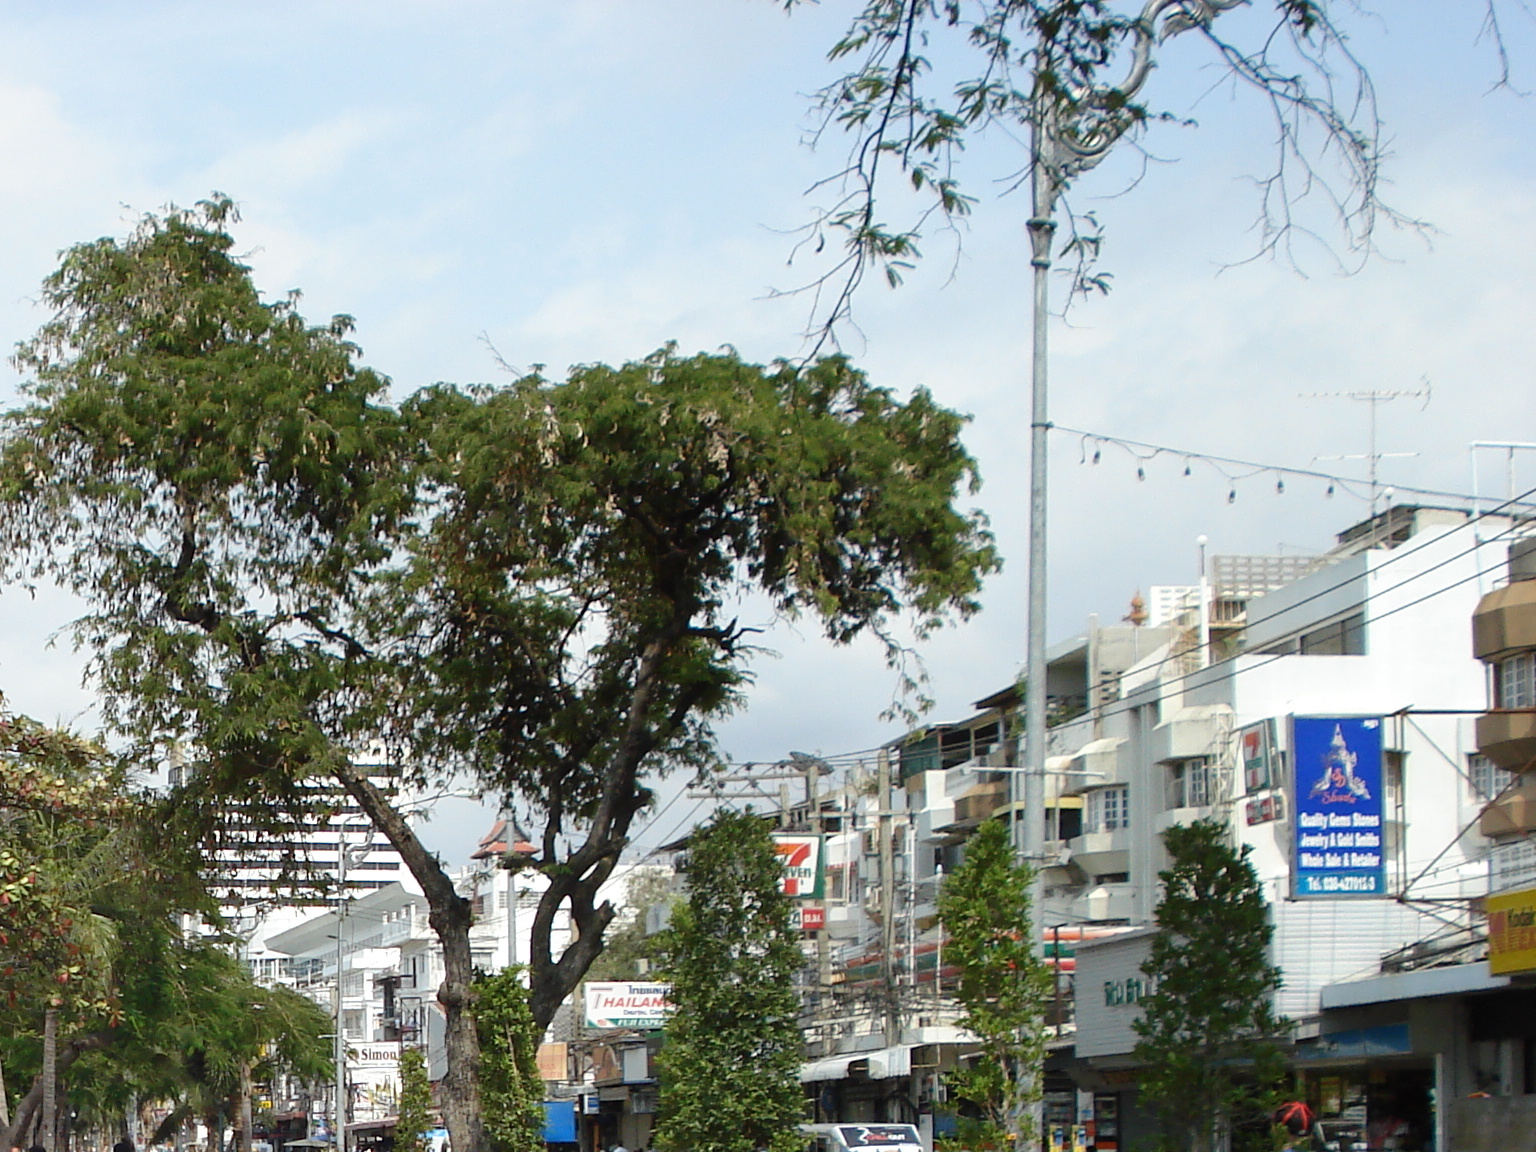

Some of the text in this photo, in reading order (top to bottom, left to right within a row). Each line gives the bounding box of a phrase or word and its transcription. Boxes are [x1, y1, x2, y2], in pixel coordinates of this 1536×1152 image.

[1301, 812, 1379, 829] Quality Gems Stones
[1301, 832, 1379, 849] Jewelry & Gold Smiths
[1301, 852, 1380, 867] Whole Sale & Retailer
[361, 1048, 397, 1060] Simon
